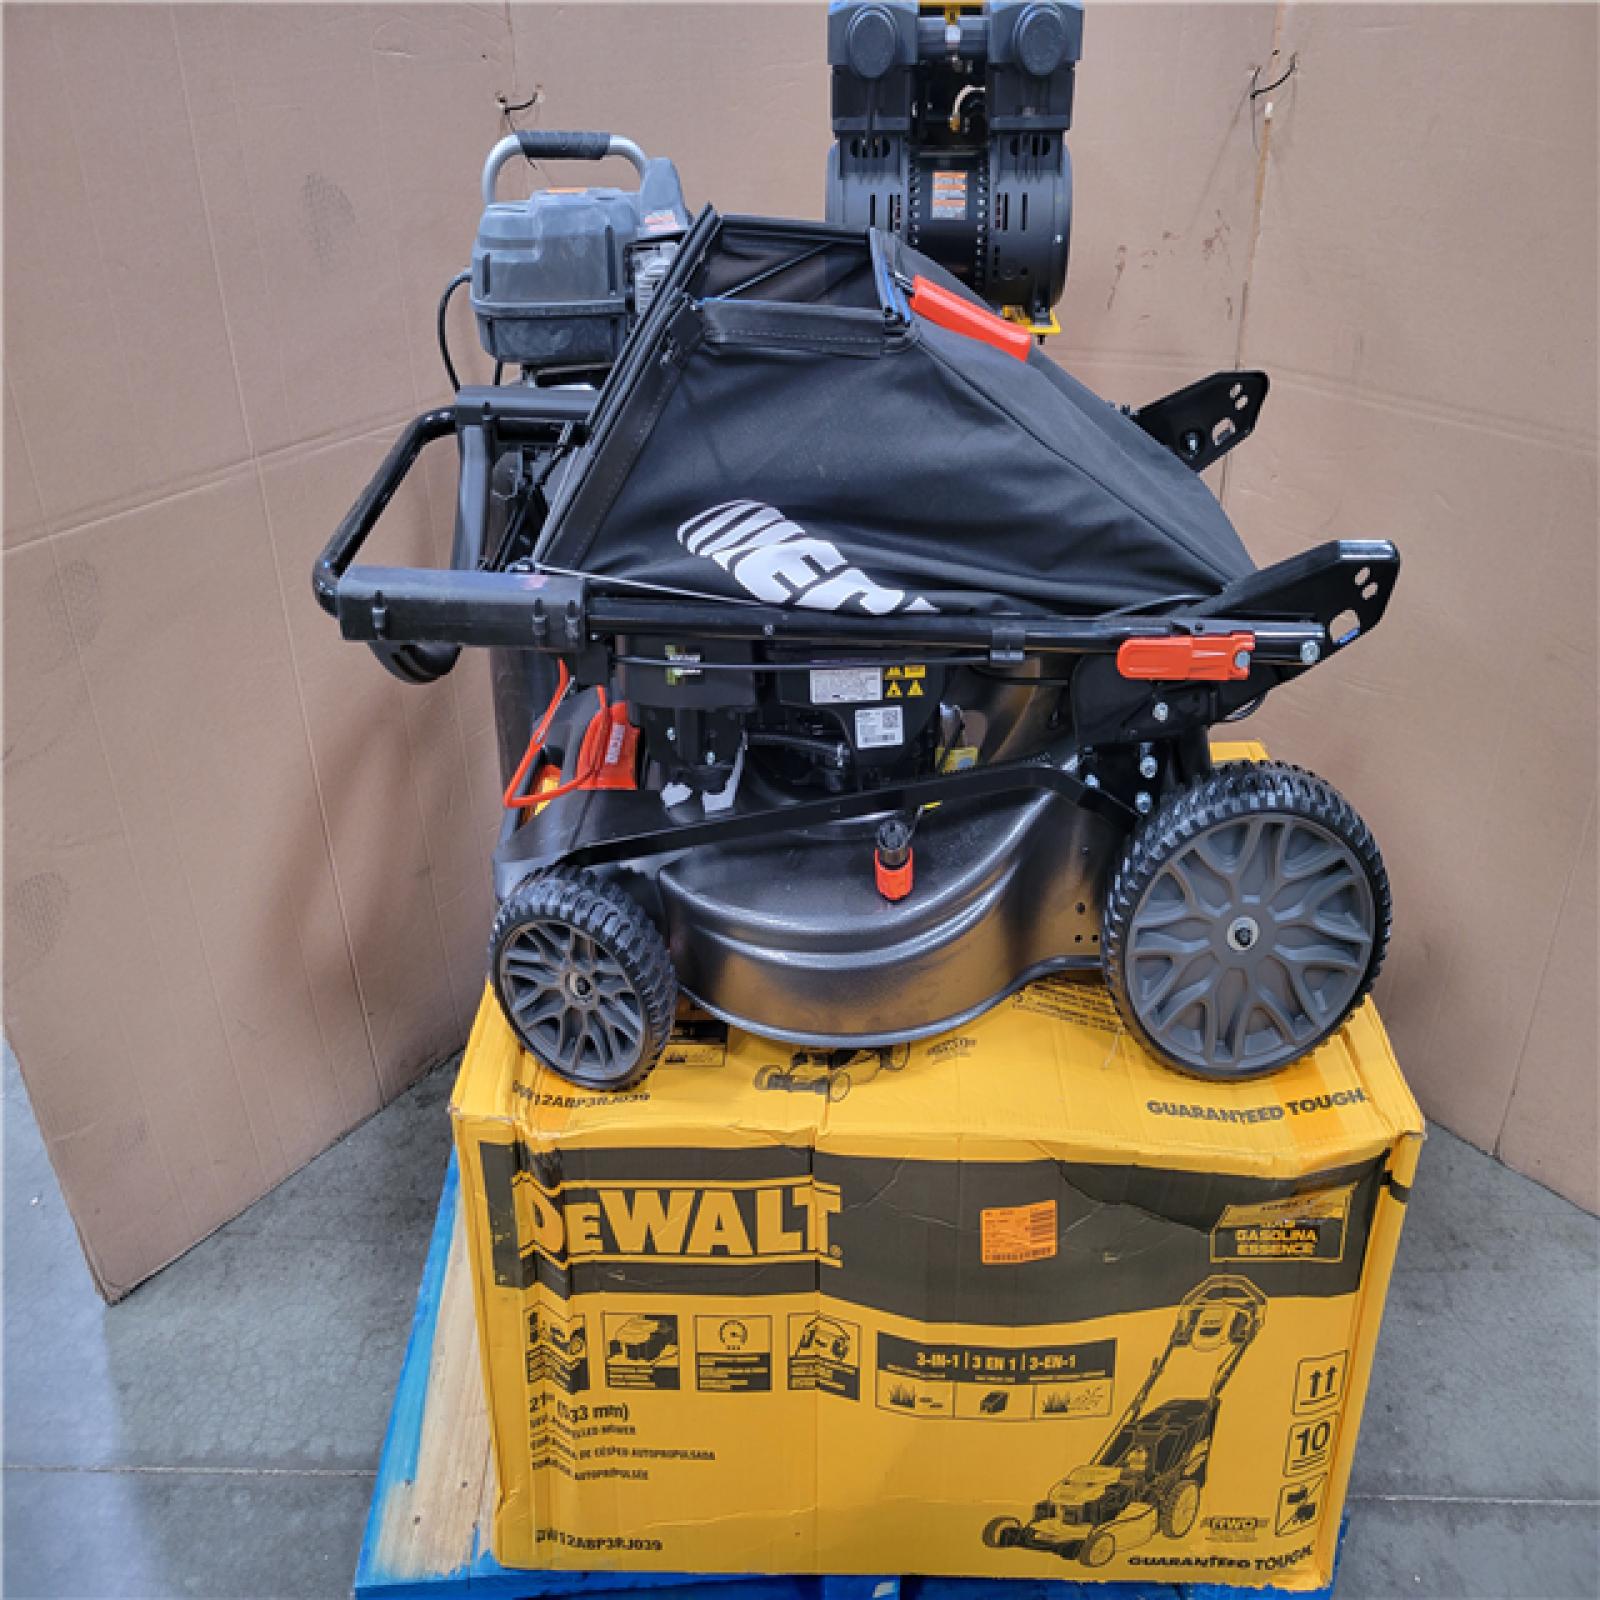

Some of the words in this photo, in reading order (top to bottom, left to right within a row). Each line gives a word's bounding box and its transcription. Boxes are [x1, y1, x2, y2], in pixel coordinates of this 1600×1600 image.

[1147, 1099, 1284, 1124] GUARANTEED
[1235, 1229, 1316, 1241] GASOLINA
[592, 1403, 629, 1422] mm)
[602, 1424, 636, 1435] MOWER
[1295, 1421, 1331, 1456] 10
[580, 1450, 591, 1460] DE
[632, 1449, 716, 1460] AUTOPROPULSADA
[1128, 1554, 1250, 1568] GUARANTEED
